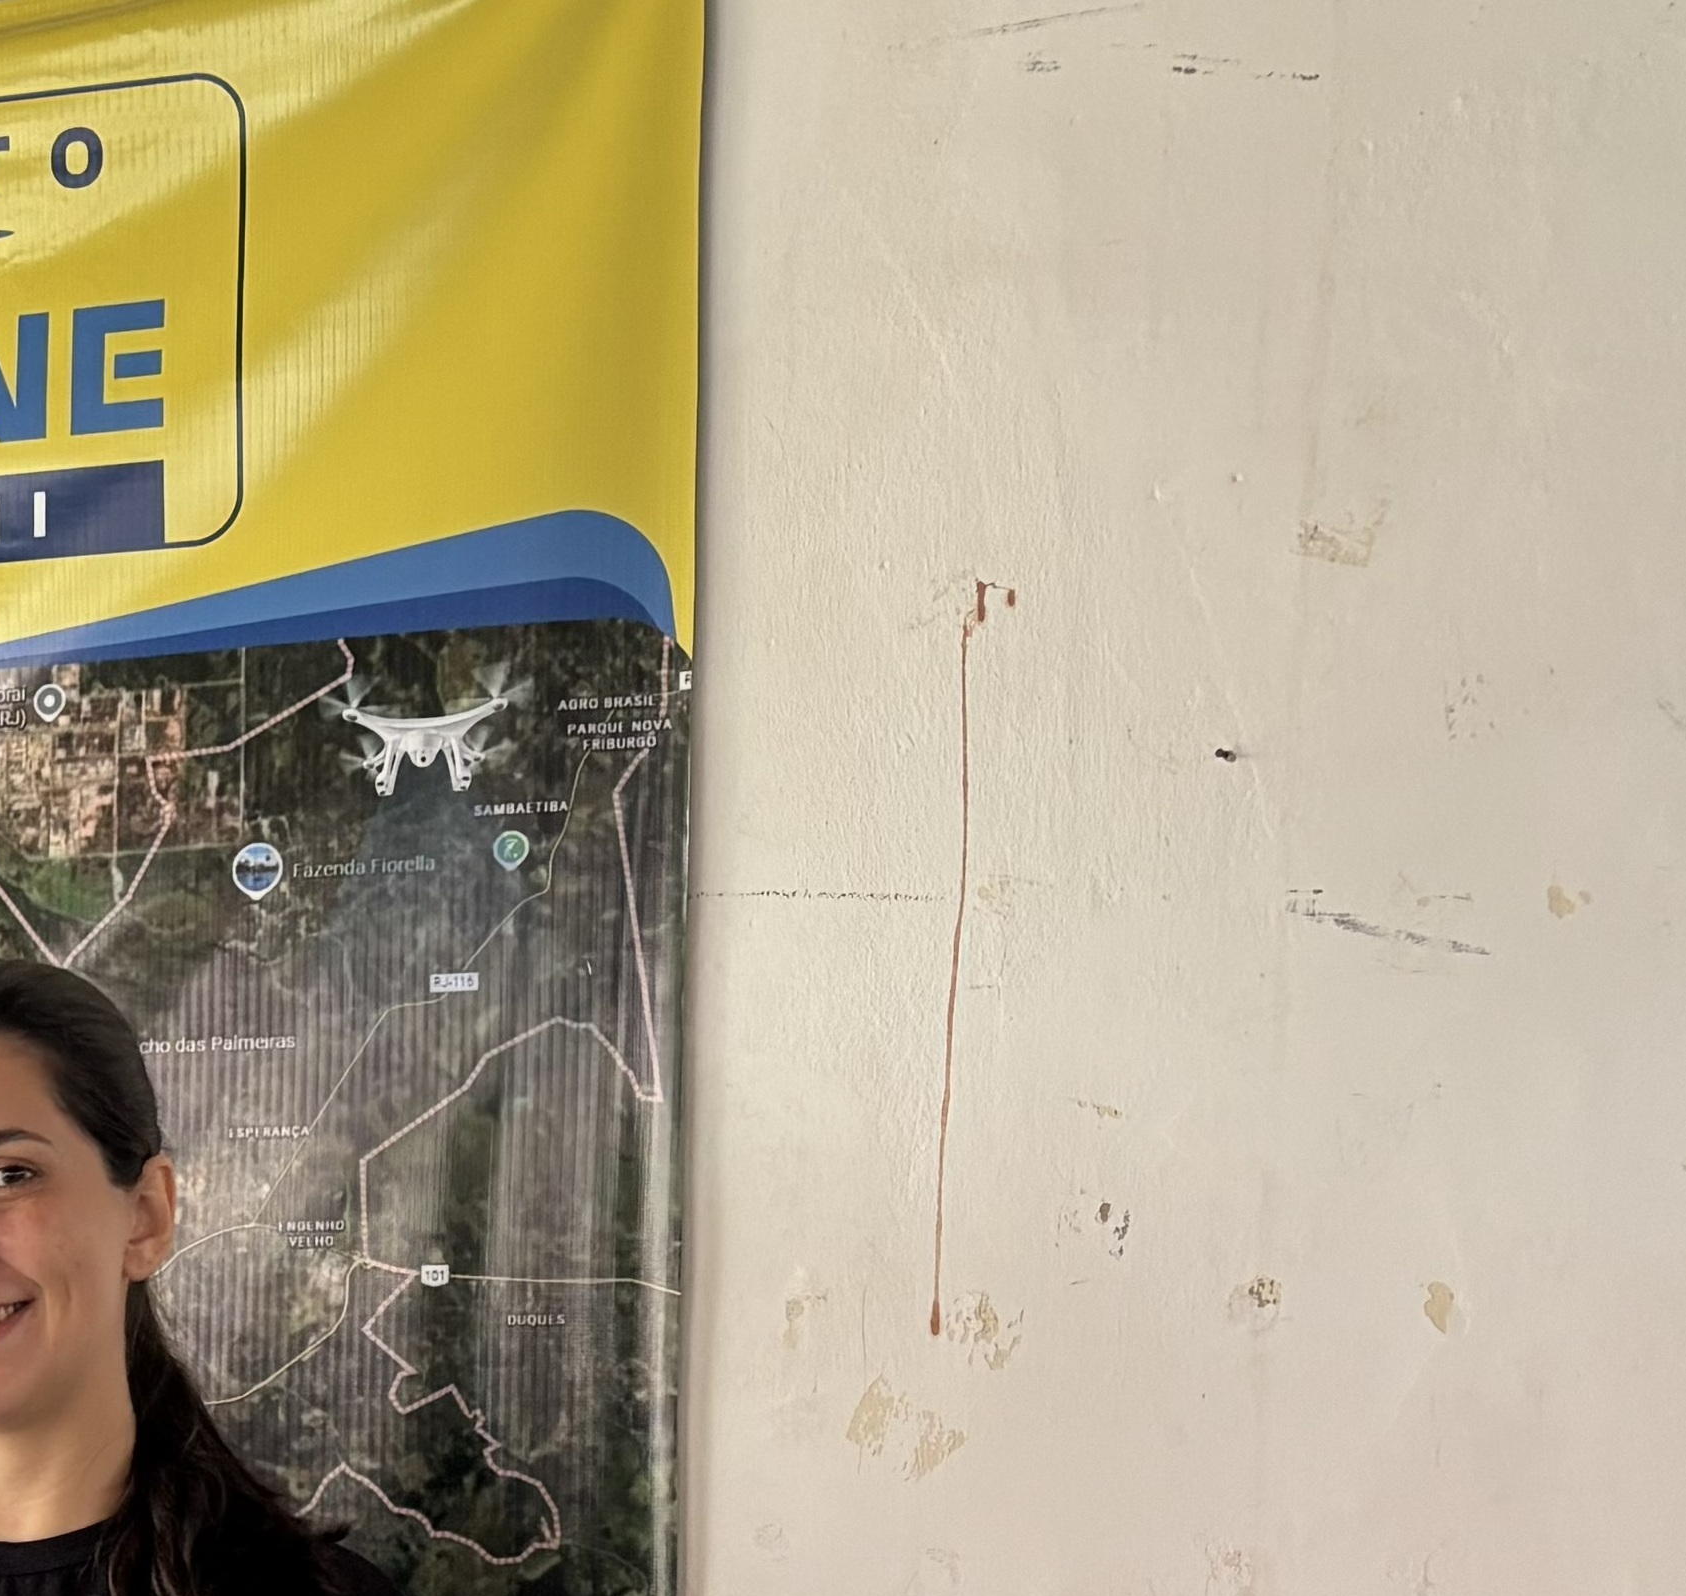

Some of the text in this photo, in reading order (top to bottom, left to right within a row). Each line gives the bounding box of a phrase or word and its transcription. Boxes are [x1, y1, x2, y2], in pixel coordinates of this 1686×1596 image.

[604, 695, 655, 708] BRASIL
[632, 719, 672, 732] NOVA
[473, 800, 570, 818] SAMBAETIBA
[291, 855, 436, 880] Fazenda Fiorella
[139, 1034, 296, 1053] cho das Palmeiras
[289, 1236, 334, 1247] VELHO
[506, 1314, 566, 1327] DUQUES
